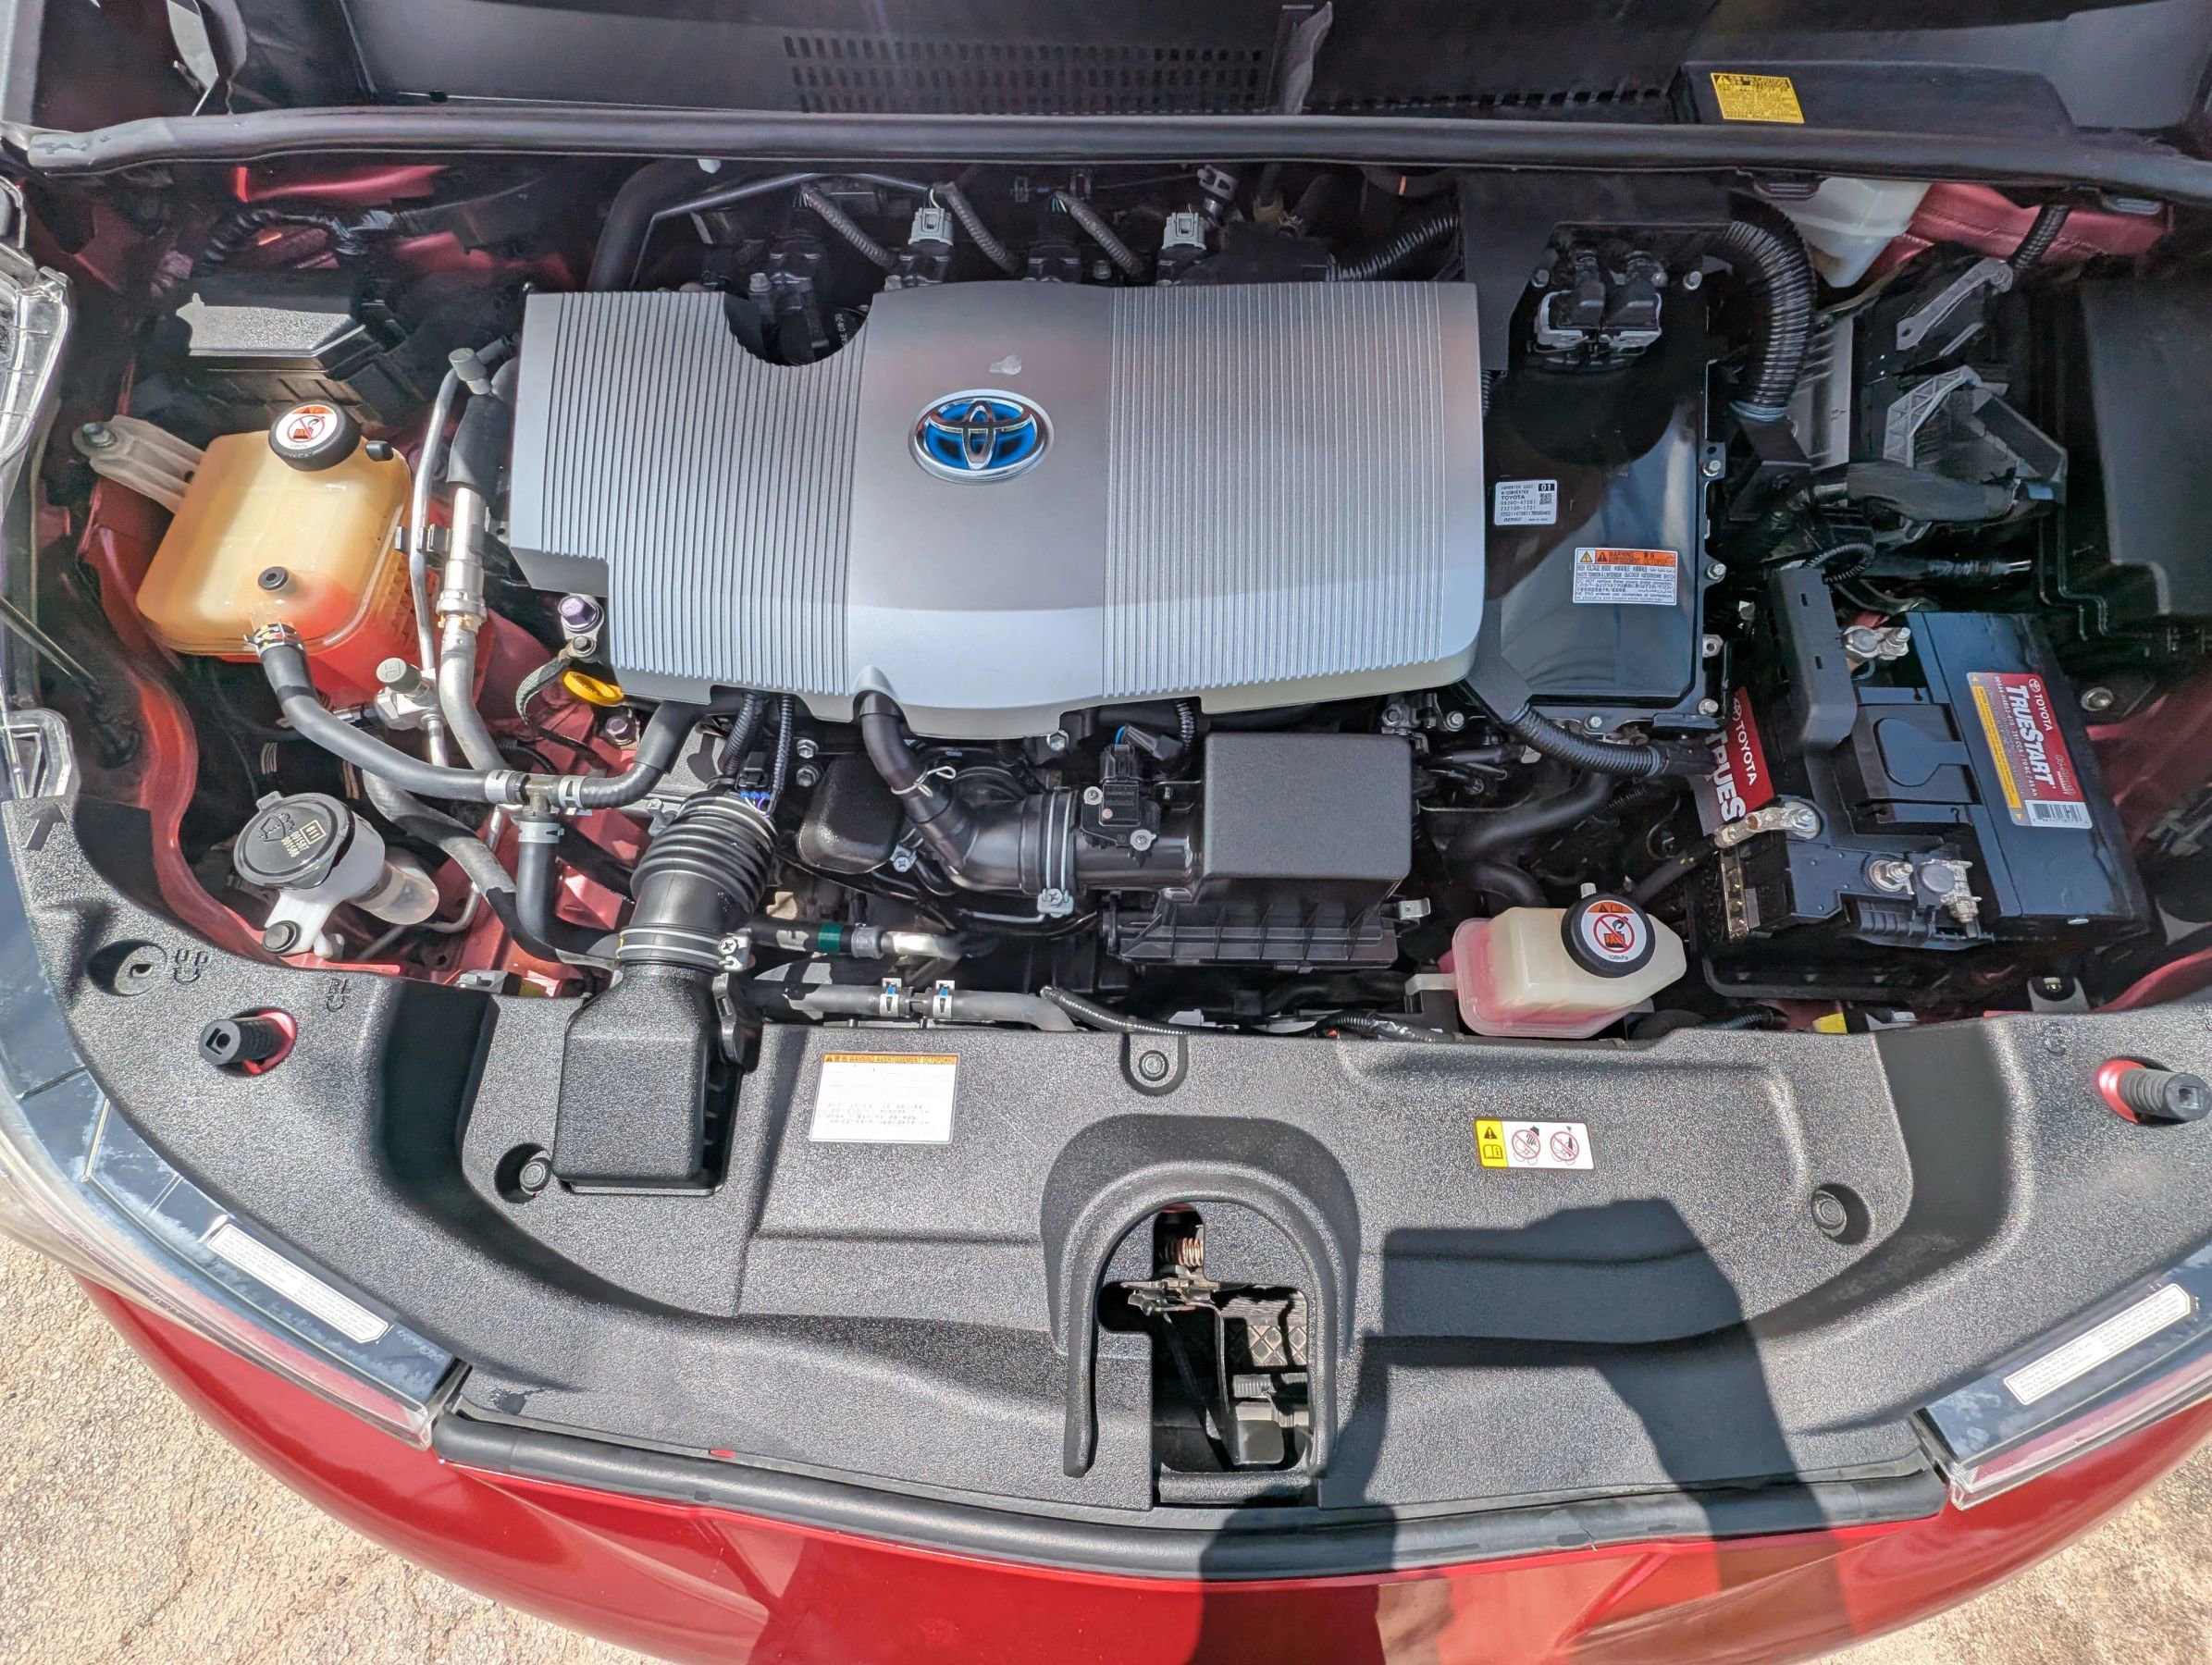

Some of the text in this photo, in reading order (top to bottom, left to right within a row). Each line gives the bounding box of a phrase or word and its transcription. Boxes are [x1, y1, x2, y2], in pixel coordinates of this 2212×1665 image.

[2034, 693, 2054, 732] TOYOTA
[1736, 721, 1757, 785] TOYOTA
[290, 831, 310, 851] 001587
